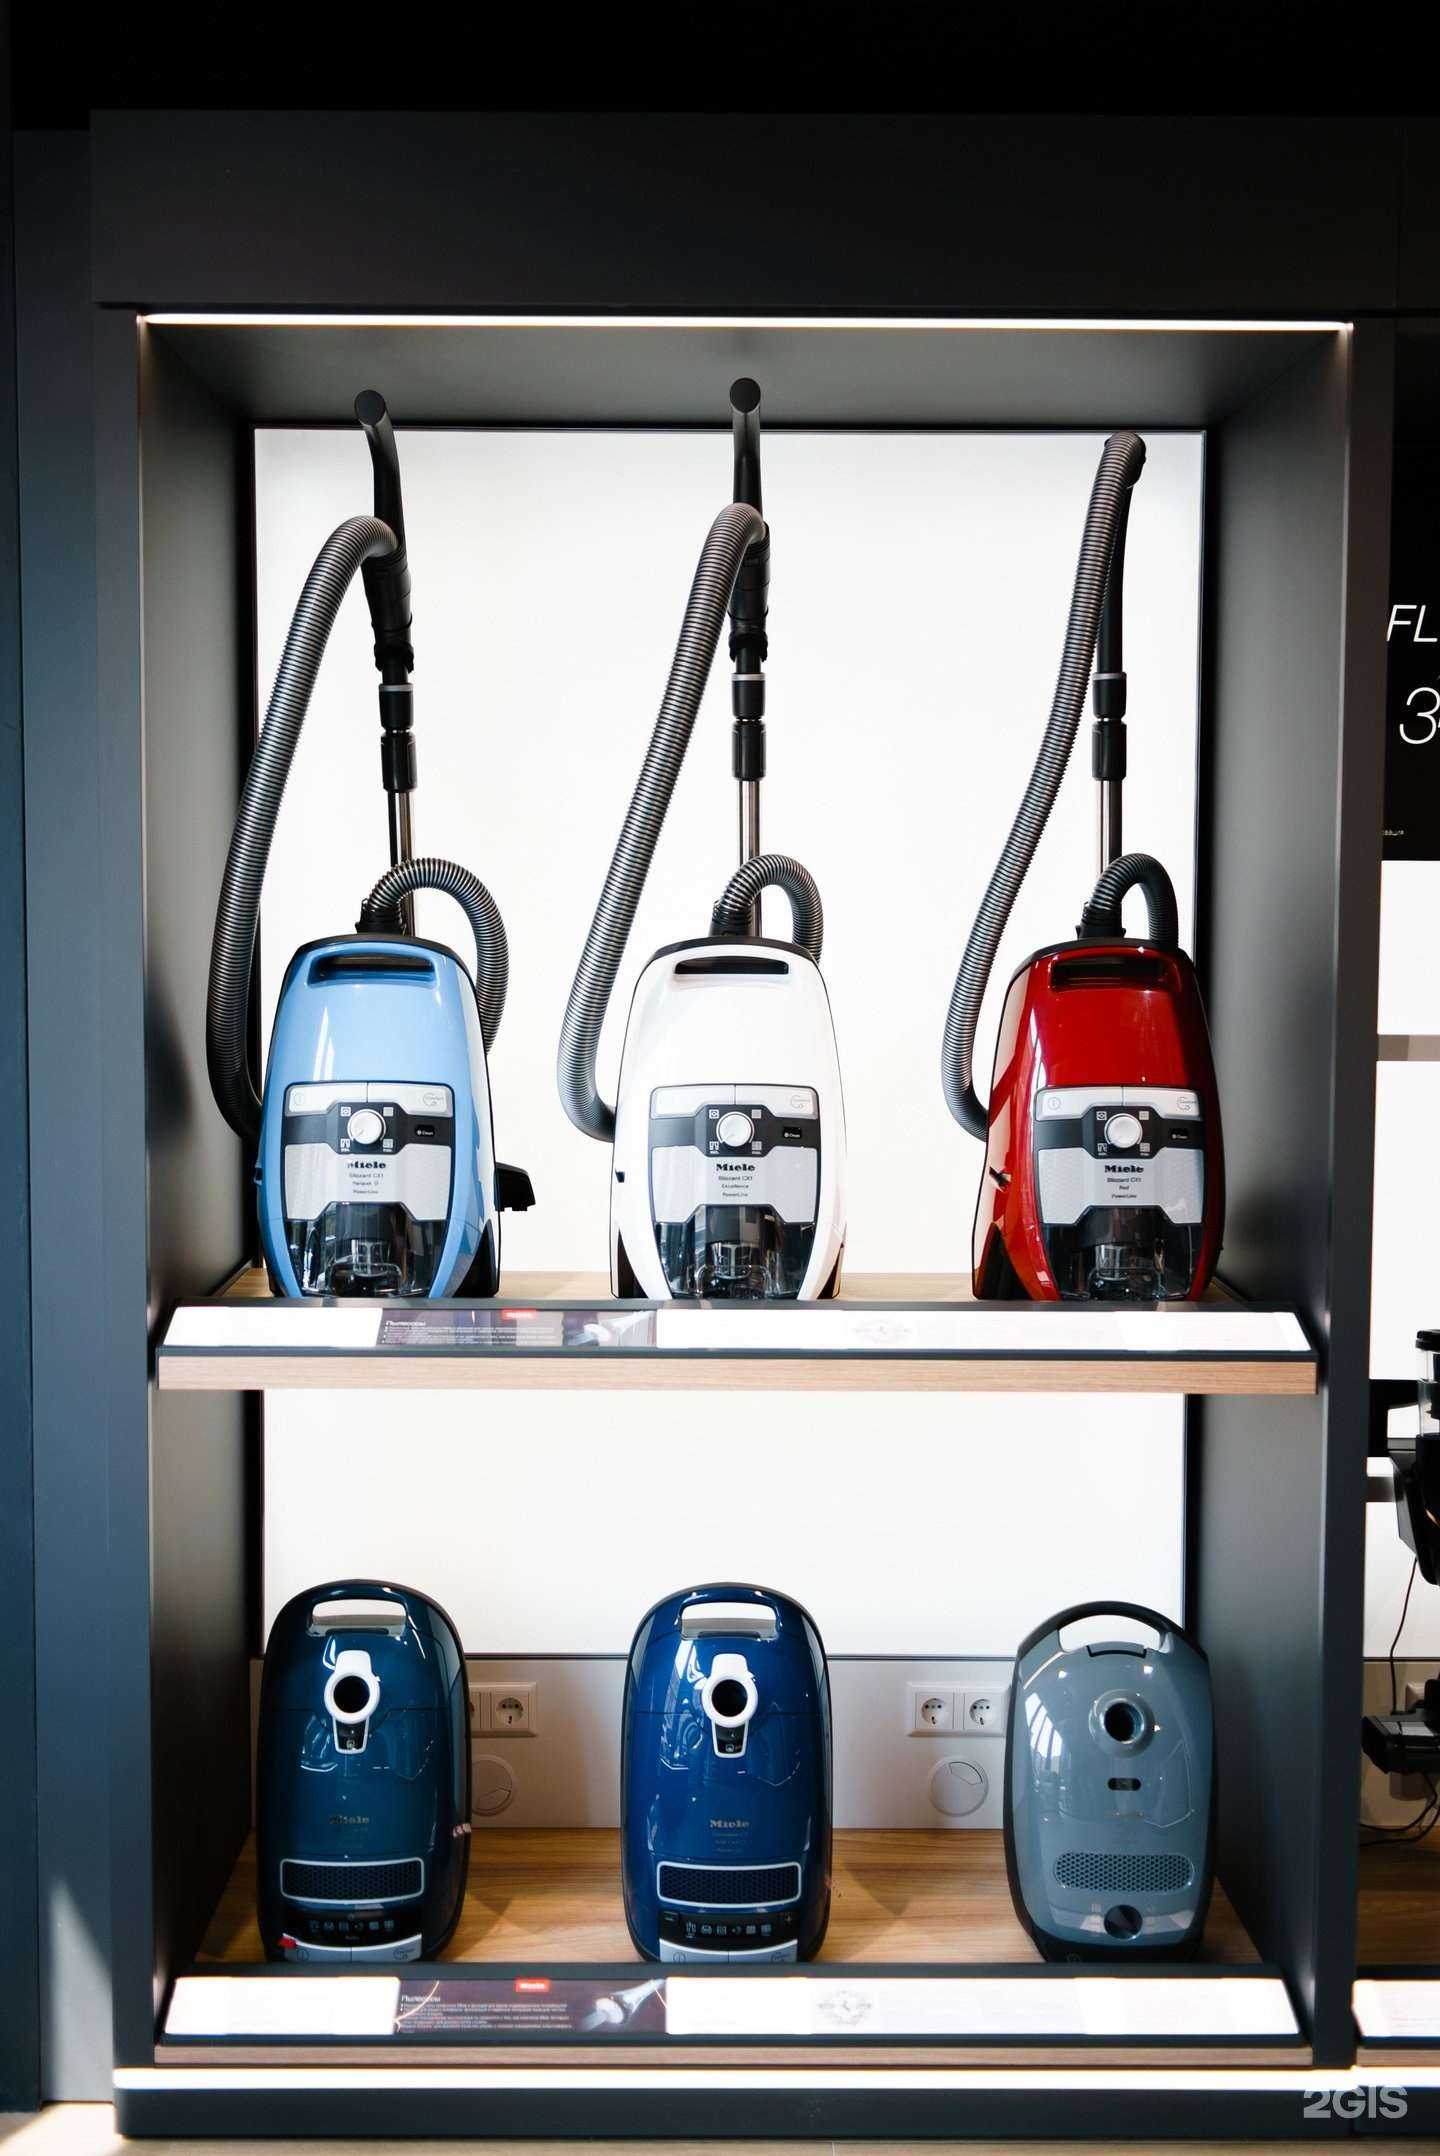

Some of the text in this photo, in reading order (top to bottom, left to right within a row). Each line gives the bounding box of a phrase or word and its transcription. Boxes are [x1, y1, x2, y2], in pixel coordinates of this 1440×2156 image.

[1386, 604, 1438, 643] FL
[1399, 687, 1440, 745] 3
[716, 1163, 756, 1171] Miele
[1104, 1165, 1144, 1173] Miele
[710, 1819, 750, 1828] Miele
